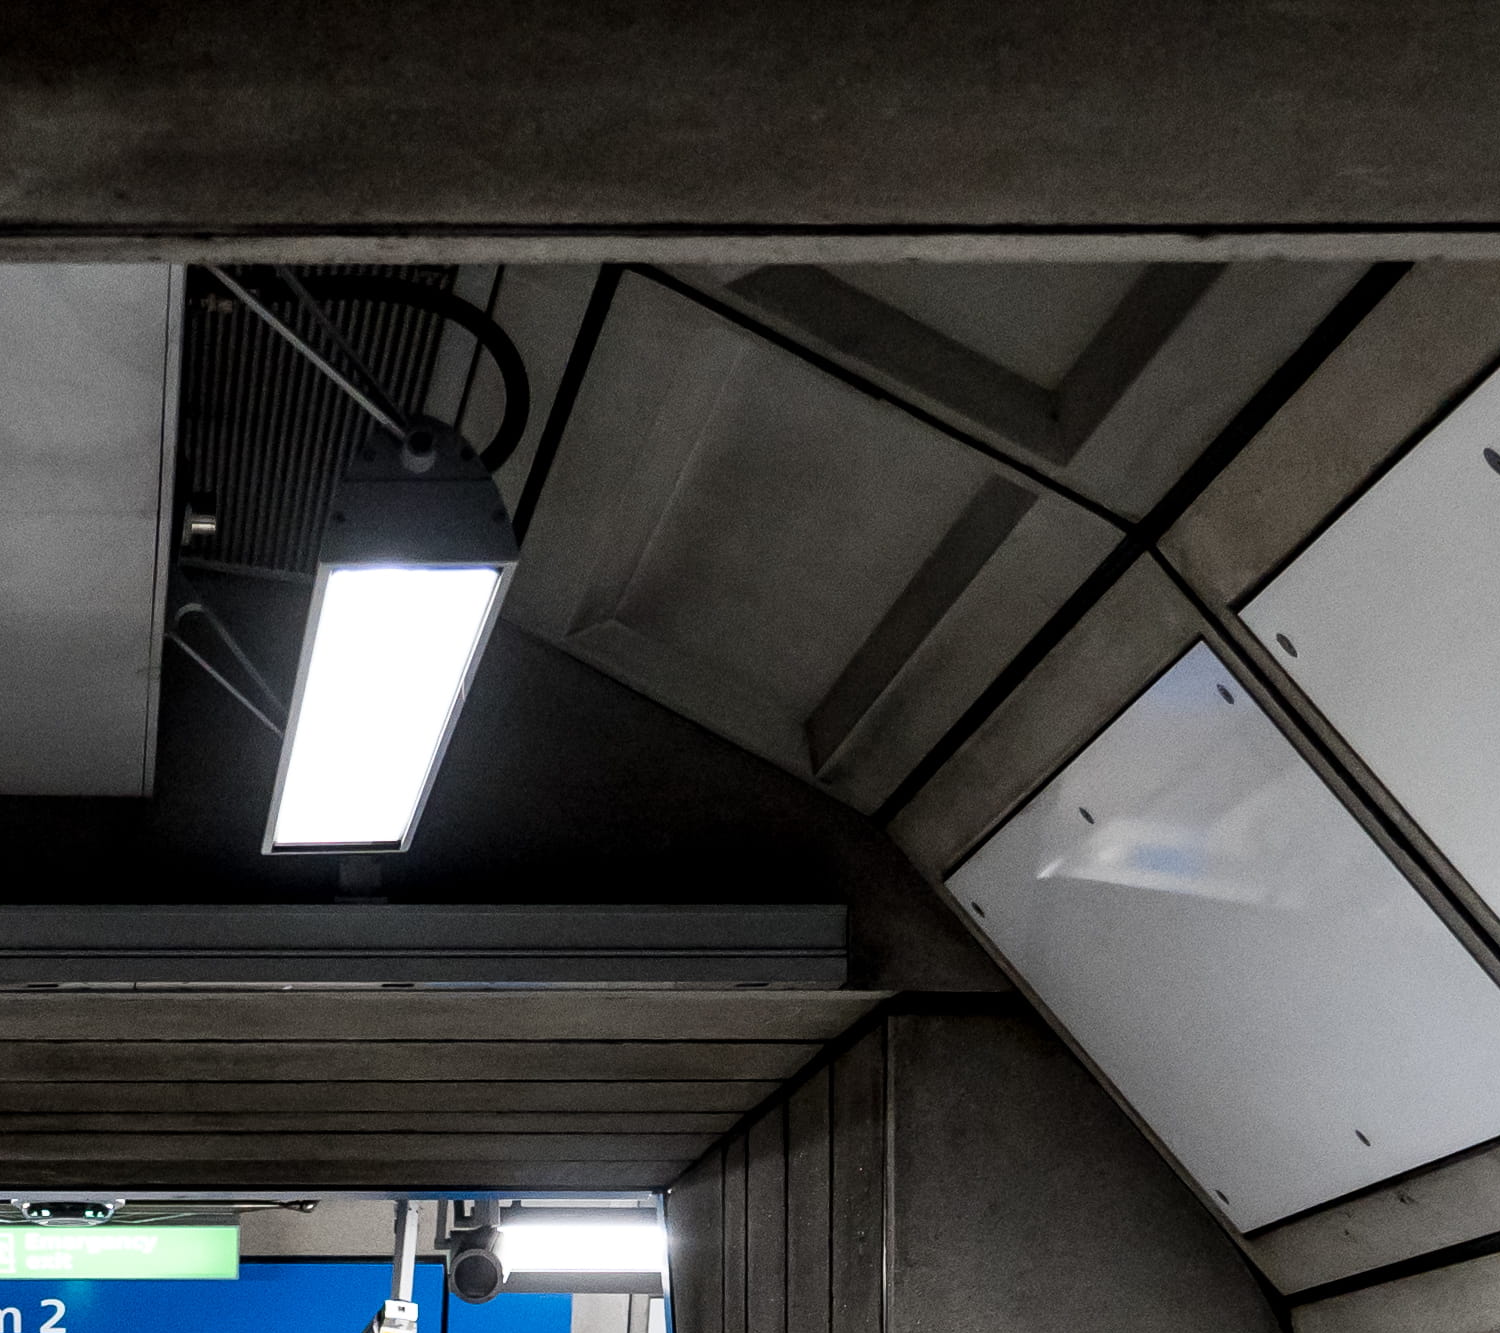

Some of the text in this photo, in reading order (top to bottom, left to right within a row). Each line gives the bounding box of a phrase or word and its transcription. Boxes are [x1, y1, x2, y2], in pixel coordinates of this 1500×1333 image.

[24, 1233, 158, 1254] Emergency
[25, 1251, 72, 1269] exit
[39, 1299, 67, 1333] 2
